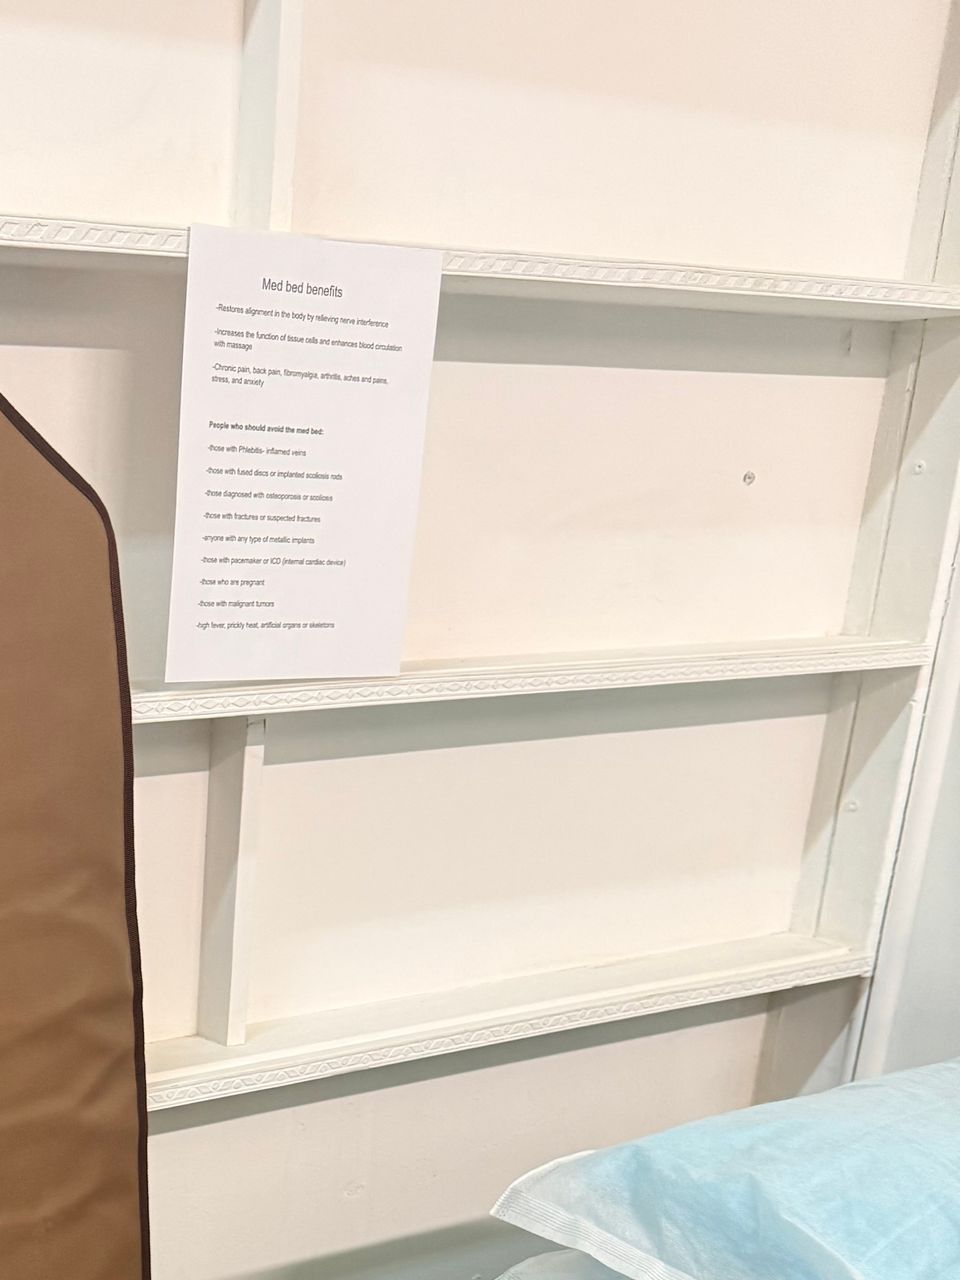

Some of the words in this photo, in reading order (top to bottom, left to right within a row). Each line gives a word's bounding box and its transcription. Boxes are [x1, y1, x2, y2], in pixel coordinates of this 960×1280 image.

[262, 278, 283, 291] Med
[286, 280, 304, 294] bed
[306, 283, 343, 298] benefits
[245, 306, 273, 317] alignment
[274, 308, 280, 317] in
[281, 310, 291, 319] the
[292, 312, 306, 322] body
[307, 313, 315, 322] by
[315, 314, 339, 325] relieving
[340, 317, 355, 325] nerve
[356, 317, 389, 328] interference
[214, 340, 225, 348] with
[226, 342, 253, 352] massage
[246, 331, 255, 339] the
[256, 331, 279, 341] function
[280, 333, 287, 342] of
[287, 335, 305, 344] tissue
[305, 336, 318, 344] cells
[319, 338, 330, 346] and
[331, 339, 358, 348] enhances
[359, 341, 374, 350] blood
[375, 344, 403, 352] circulation
[253, 366, 266, 375] back
[343, 374, 360, 382] aches
[231, 377, 242, 385] and
[243, 378, 264, 388] anxiety
[209, 421, 229, 431] People
[231, 422, 243, 430] who
[245, 423, 266, 432] should
[226, 445, 237, 453] with
[266, 447, 290, 456] inflamed
[237, 468, 253, 476] fused
[254, 469, 269, 477] discs
[277, 470, 305, 480] implanted
[306, 472, 329, 480] scoliosis
[223, 490, 252, 499] diagnosed
[253, 491, 264, 499] with
[266, 492, 301, 502] osteoporosis
[222, 512, 233, 520] with
[234, 512, 258, 521] fractures
[267, 514, 295, 522] suspected
[297, 514, 321, 523] fractures
[237, 536, 248, 544] any
[249, 536, 261, 544] type
[269, 536, 290, 544] metallic
[291, 537, 315, 545] implants
[231, 557, 262, 565] pacemaker
[282, 558, 304, 566] (internal
[305, 558, 325, 566] cardiac
[326, 559, 346, 567] device)
[240, 579, 265, 588] pregnant
[228, 600, 255, 608] malignant
[227, 622, 245, 630] prickly
